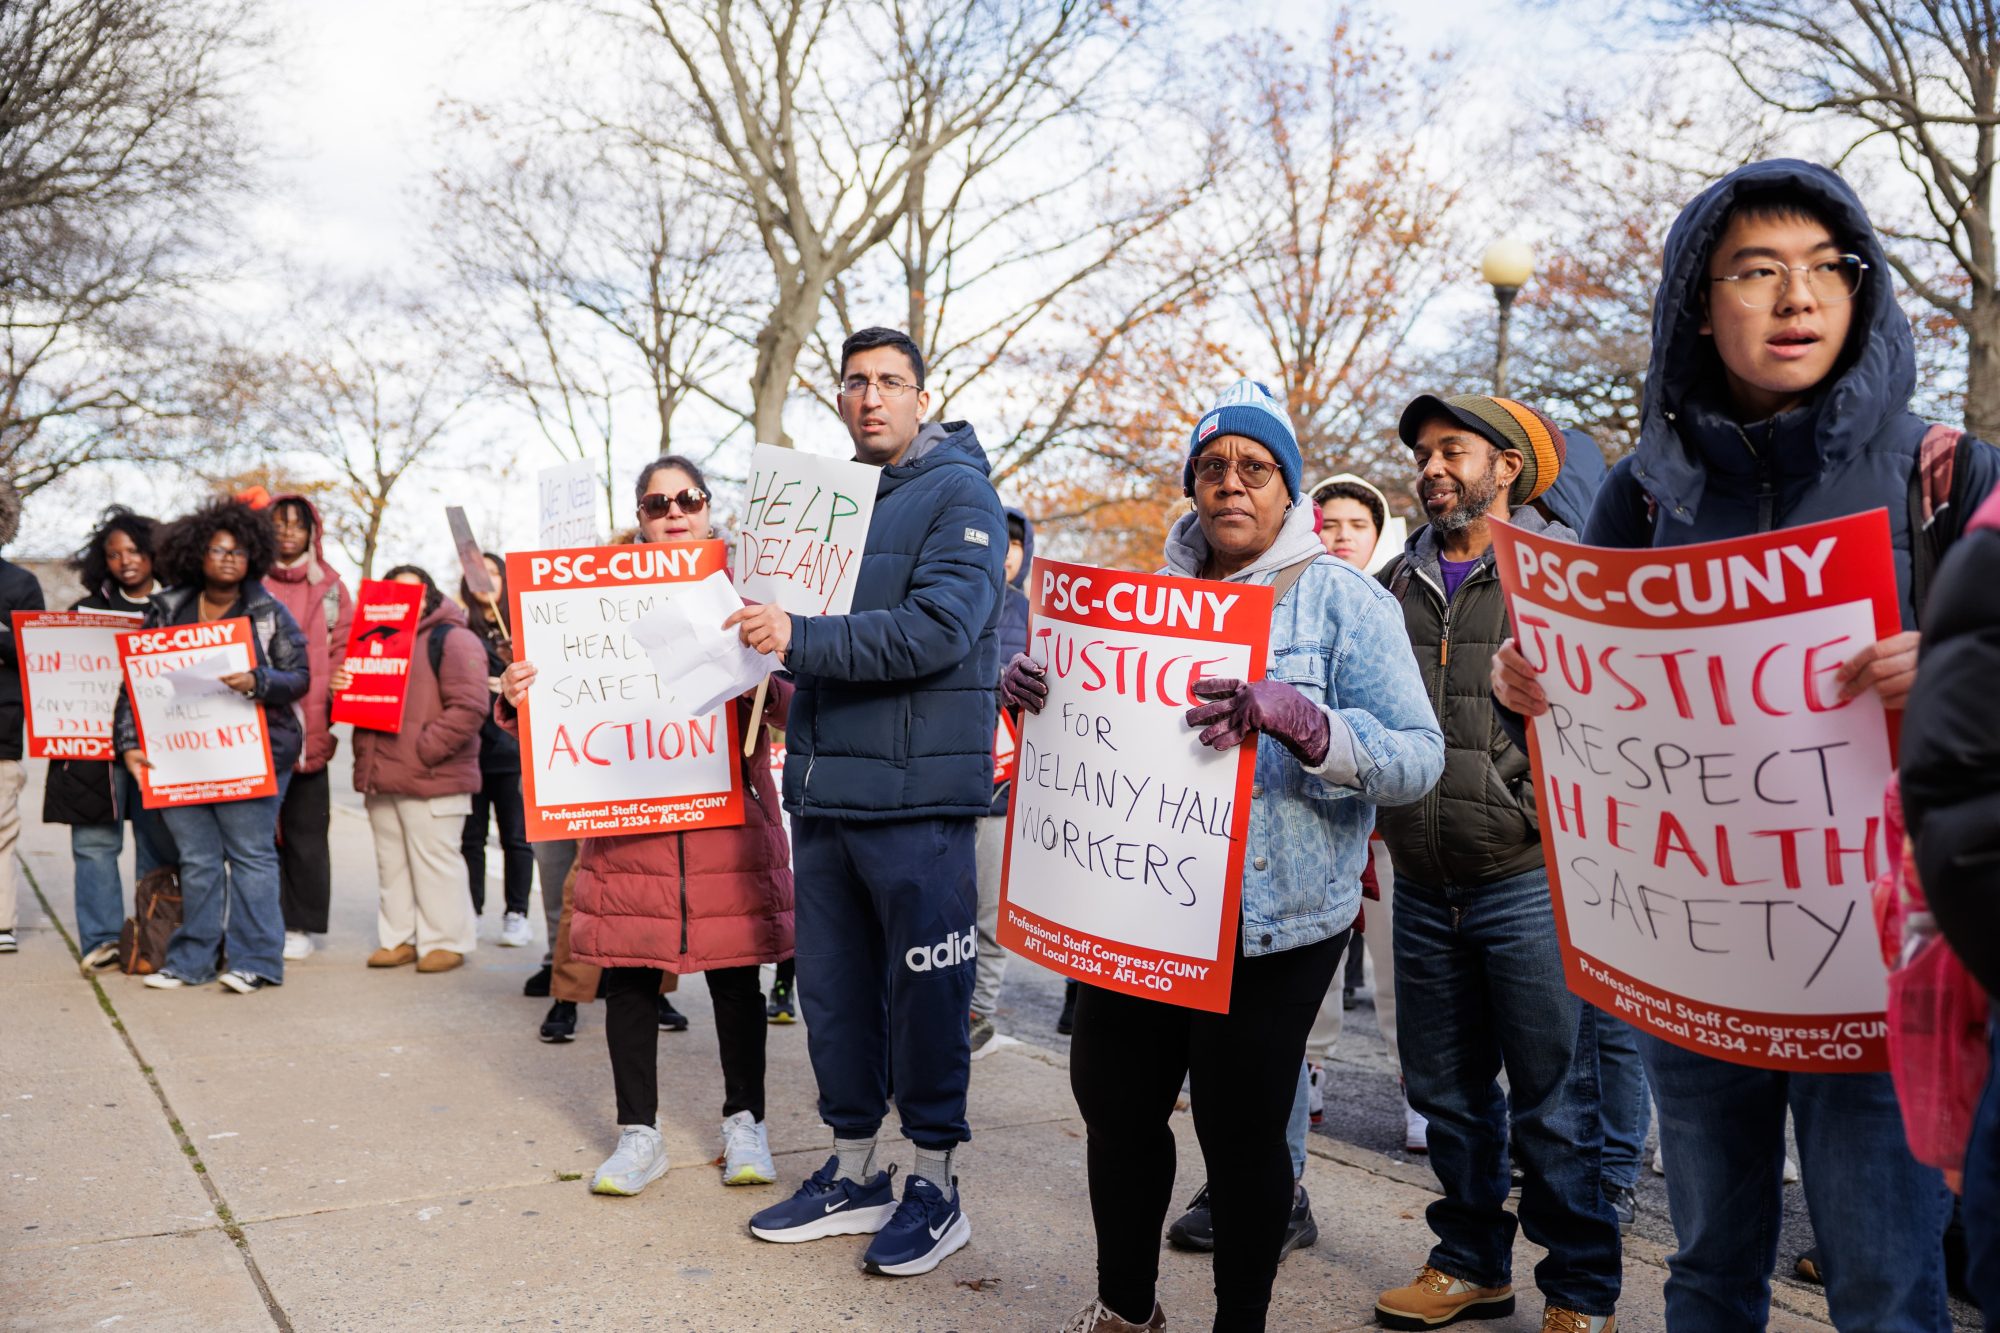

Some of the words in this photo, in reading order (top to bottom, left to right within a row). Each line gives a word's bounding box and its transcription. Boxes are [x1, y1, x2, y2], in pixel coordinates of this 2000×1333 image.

[744, 471, 859, 542] HELP
[531, 548, 703, 585] PSC-CUNY
[742, 531, 853, 615] DELANY
[1513, 536, 1838, 618] PSC-CUNY
[529, 602, 568, 624] WE
[599, 596, 669, 623] DEM
[1042, 570, 1240, 632] PSC-CUNY
[128, 623, 236, 654] PSC-CUNY
[563, 633, 649, 662] HEAL
[1034, 628, 1229, 707] JUSTICE
[553, 673, 676, 708] SAFET
[1515, 613, 1855, 726] JUSTICE
[148, 723, 259, 753] STUDENTS
[163, 702, 212, 721] HALL
[1062, 702, 1118, 751] FOR
[43, 738, 115, 756] -CUNY
[549, 715, 718, 770] ACTION
[1548, 701, 1850, 817] RESPECT
[541, 805, 608, 822] Professional
[611, 804, 638, 816] Staff
[639, 797, 728, 814] Congress/CUNY
[1024, 738, 1151, 823] DELANY
[1157, 783, 1239, 842] HALL
[567, 820, 587, 832] AFT
[590, 818, 619, 829] Local
[622, 815, 650, 827] 2334
[660, 811, 704, 825] AFL-CIO
[1550, 774, 1879, 890] HEALTH
[1020, 800, 1199, 907] WORKERS
[905, 925, 978, 972] adid
[1008, 910, 1061, 945] Professional
[1063, 934, 1091, 954] Staff
[1092, 945, 1209, 981] Congress/CUNY
[1570, 856, 1856, 990] SAFETY
[1024, 936, 1041, 953] AFT
[1042, 943, 1068, 964] Local
[1071, 954, 1102, 976] 2334
[1112, 967, 1173, 992] AFL-CIO
[1580, 956, 1671, 1014] Professional
[1676, 1003, 1722, 1029] Staff
[1725, 1016, 1889, 1042] Congress/CUN
[1614, 994, 1642, 1017] AFT
[1646, 1007, 1690, 1039] Local
[1695, 1027, 1747, 1052] 2334
[1767, 1041, 1863, 1060] AFL-CIO
